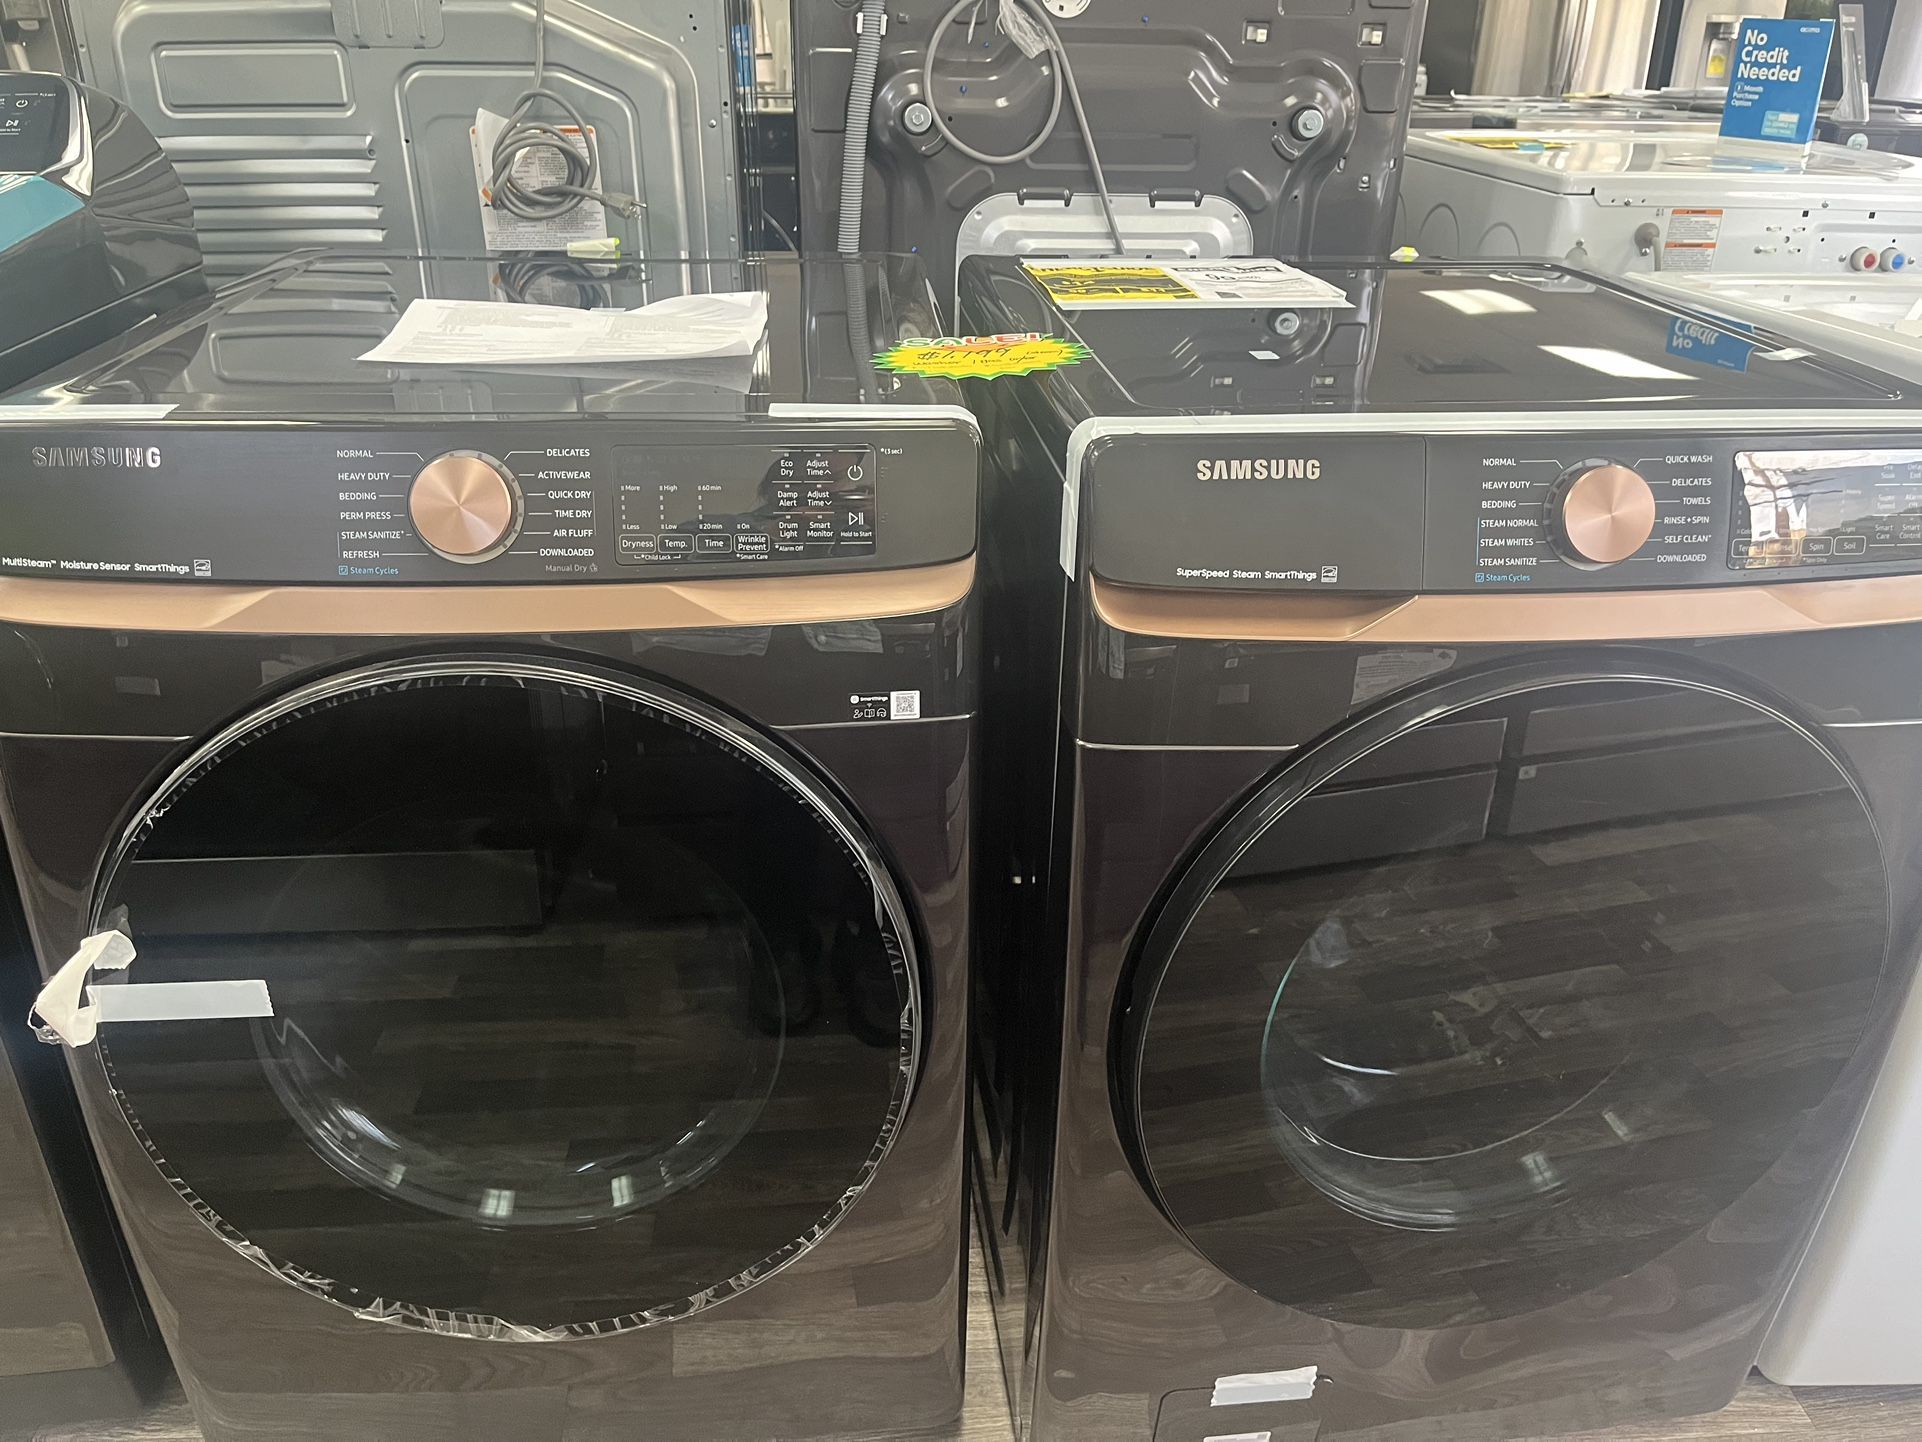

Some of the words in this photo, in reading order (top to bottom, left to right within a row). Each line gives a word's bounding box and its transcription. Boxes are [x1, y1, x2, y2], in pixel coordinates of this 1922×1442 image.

[1744, 29, 1768, 45] No
[1742, 46, 1789, 64] Credit
[1737, 62, 1801, 82] Needed
[32, 446, 161, 468] SAMSUNG
[1689, 455, 1712, 463] WASH
[806, 460, 828, 468] Adjust
[1483, 458, 1516, 466] NORMAL
[781, 469, 794, 477] Dry
[1196, 459, 1321, 481] SAMSUNG
[778, 491, 798, 499] Damp
[807, 491, 829, 499] Adjust
[341, 531, 367, 539] STEAM
[780, 530, 797, 538] Light
[622, 540, 653, 549] Dryness
[665, 540, 687, 548] Temp.
[1809, 543, 1824, 551] Spin
[343, 550, 380, 558] REFRESH
[540, 549, 594, 557] DOWNLOADED
[1480, 558, 1504, 566] STEAM
[1506, 557, 1537, 565] SANITIZE
[1657, 554, 1707, 562] DOWNLOADED
[60, 560, 99, 569] Moisture
[100, 562, 131, 570] Sensor
[134, 563, 190, 574] SmartThings
[574, 565, 587, 574] Dry
[350, 567, 374, 575] Steam
[375, 567, 398, 576] Cycles
[1176, 568, 1229, 579] SuperSpeed
[1232, 570, 1261, 579] Steam
[1265, 570, 1317, 582] SmartThings
[1508, 574, 1530, 583] Cycles
